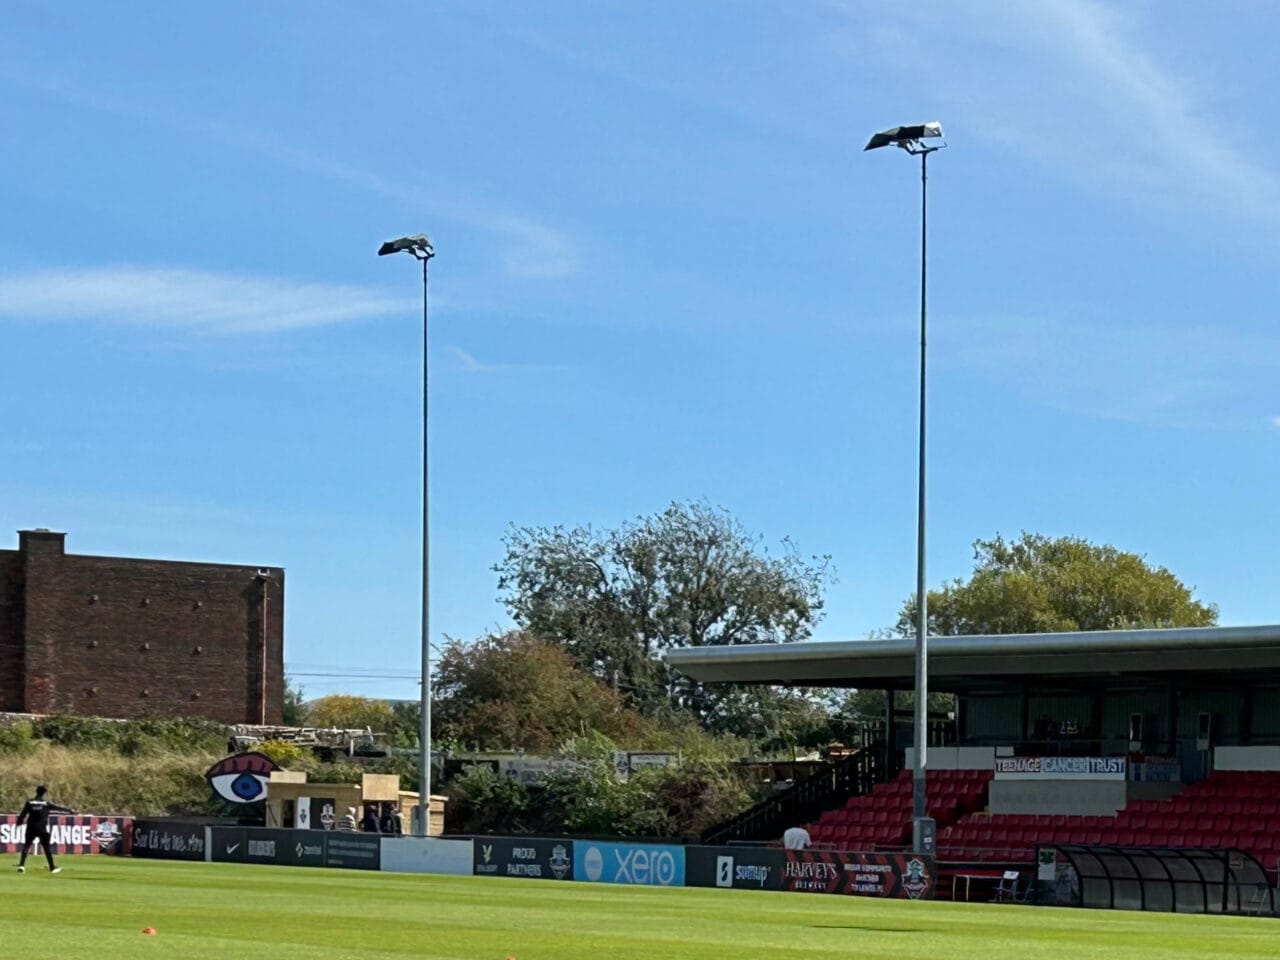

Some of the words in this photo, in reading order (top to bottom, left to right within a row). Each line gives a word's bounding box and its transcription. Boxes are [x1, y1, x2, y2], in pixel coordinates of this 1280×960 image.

[996, 758, 1041, 773] TEENAGE
[1045, 757, 1088, 773] CANCER
[1090, 758, 1124, 773] TRUST
[512, 847, 536, 860] PROUD
[614, 848, 675, 884] xero
